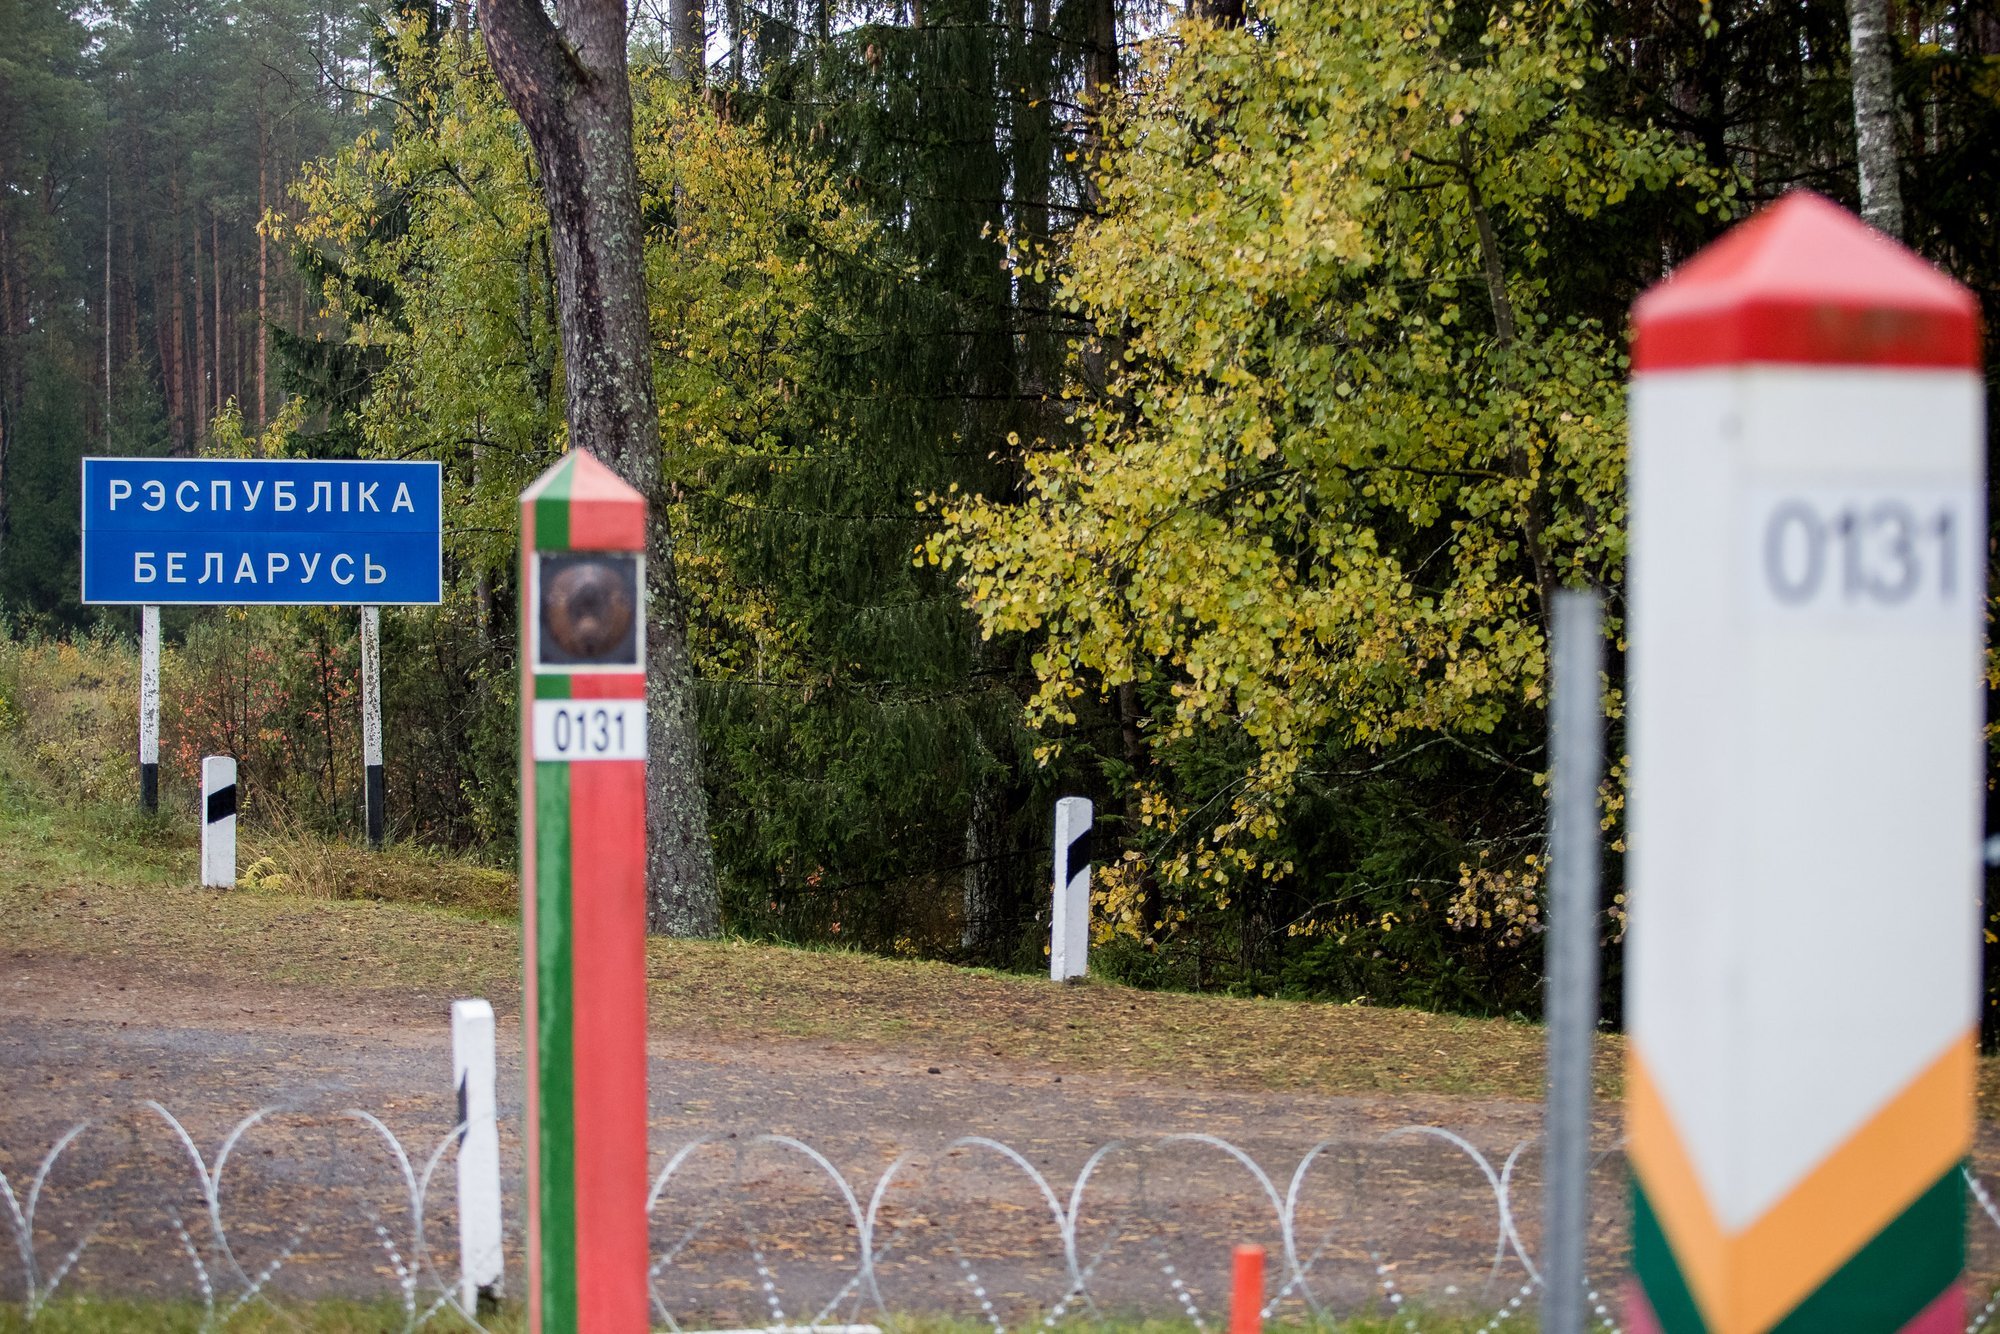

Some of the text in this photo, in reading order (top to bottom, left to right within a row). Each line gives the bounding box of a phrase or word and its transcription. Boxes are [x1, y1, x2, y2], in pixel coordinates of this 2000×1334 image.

[109, 479, 415, 513] РЭСПУБЛІКА
[134, 552, 387, 585] БЕЛАРУСЬ
[1764, 499, 1958, 606] 0131
[554, 709, 624, 752] 0131
